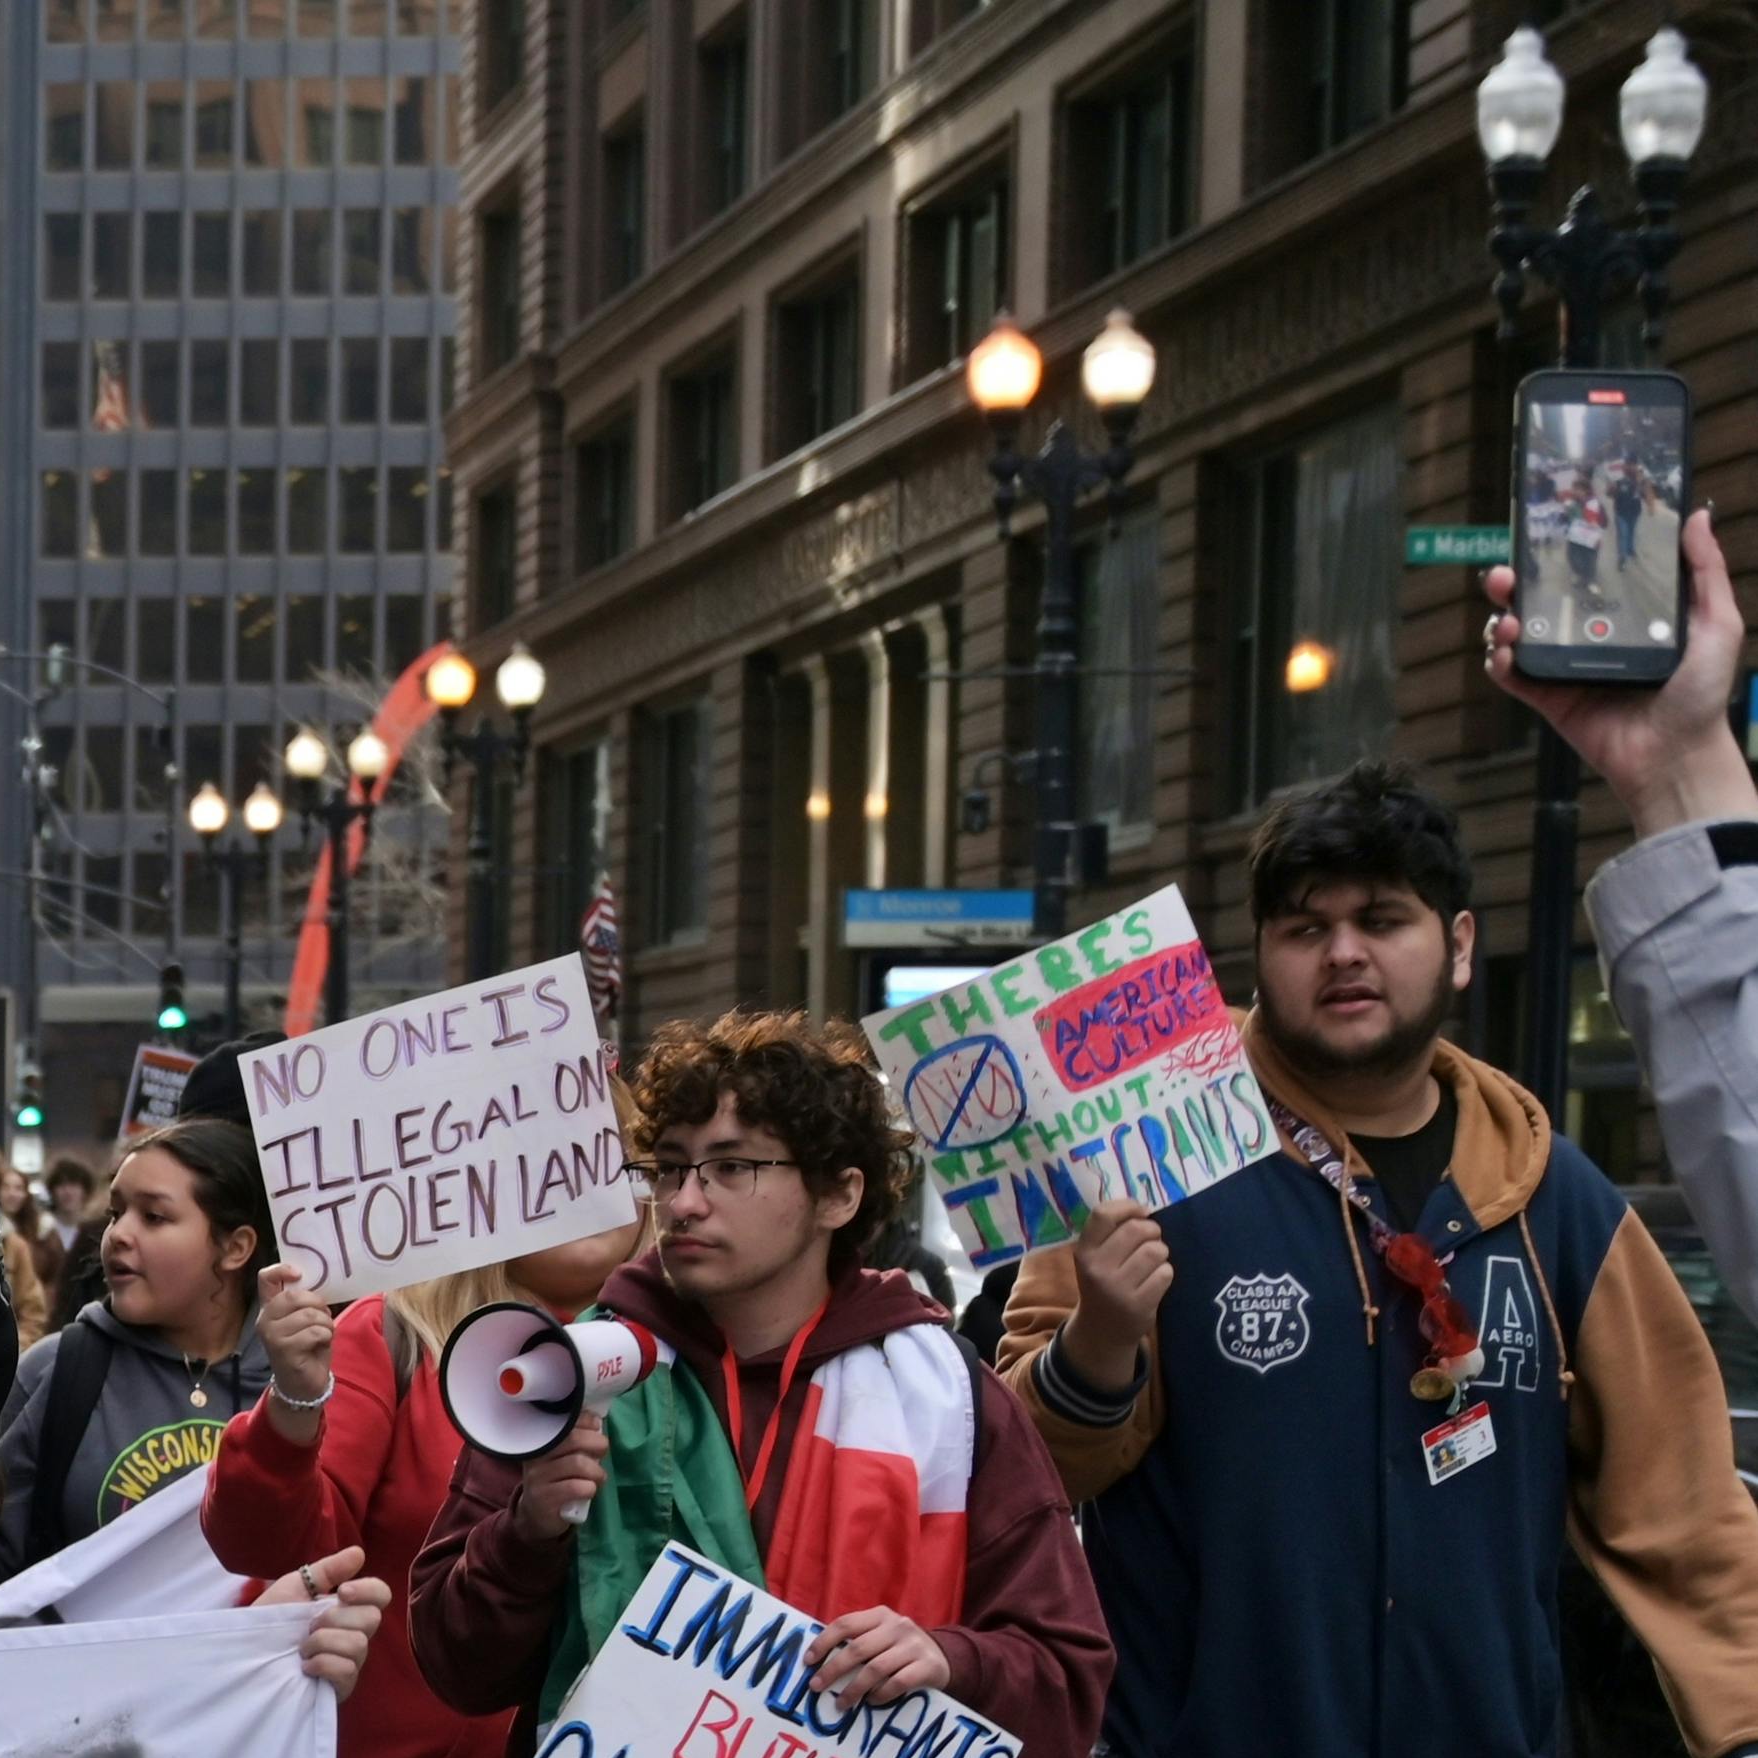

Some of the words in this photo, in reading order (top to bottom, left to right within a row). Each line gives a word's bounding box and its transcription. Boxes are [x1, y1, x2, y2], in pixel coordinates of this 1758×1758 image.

[252, 1043, 327, 1117] NO
[360, 1003, 472, 1081] ONE
[481, 974, 571, 1047] IS
[261, 1083, 539, 1199] ILLEGAL
[554, 1048, 606, 1113] ON
[280, 1160, 497, 1293] STOLEN
[518, 1127, 625, 1223] LAND
[1226, 1285, 1274, 1300] CLASS
[1277, 1285, 1298, 1297] AA
[1232, 1298, 1292, 1312] LEAGUE
[1241, 1311, 1283, 1342] 87
[1488, 1328, 1534, 1348] AERO
[1230, 1337, 1295, 1360] CHAMPS
[597, 1355, 622, 1382] PYLE
[108, 1426, 221, 1502] WISCONSI
